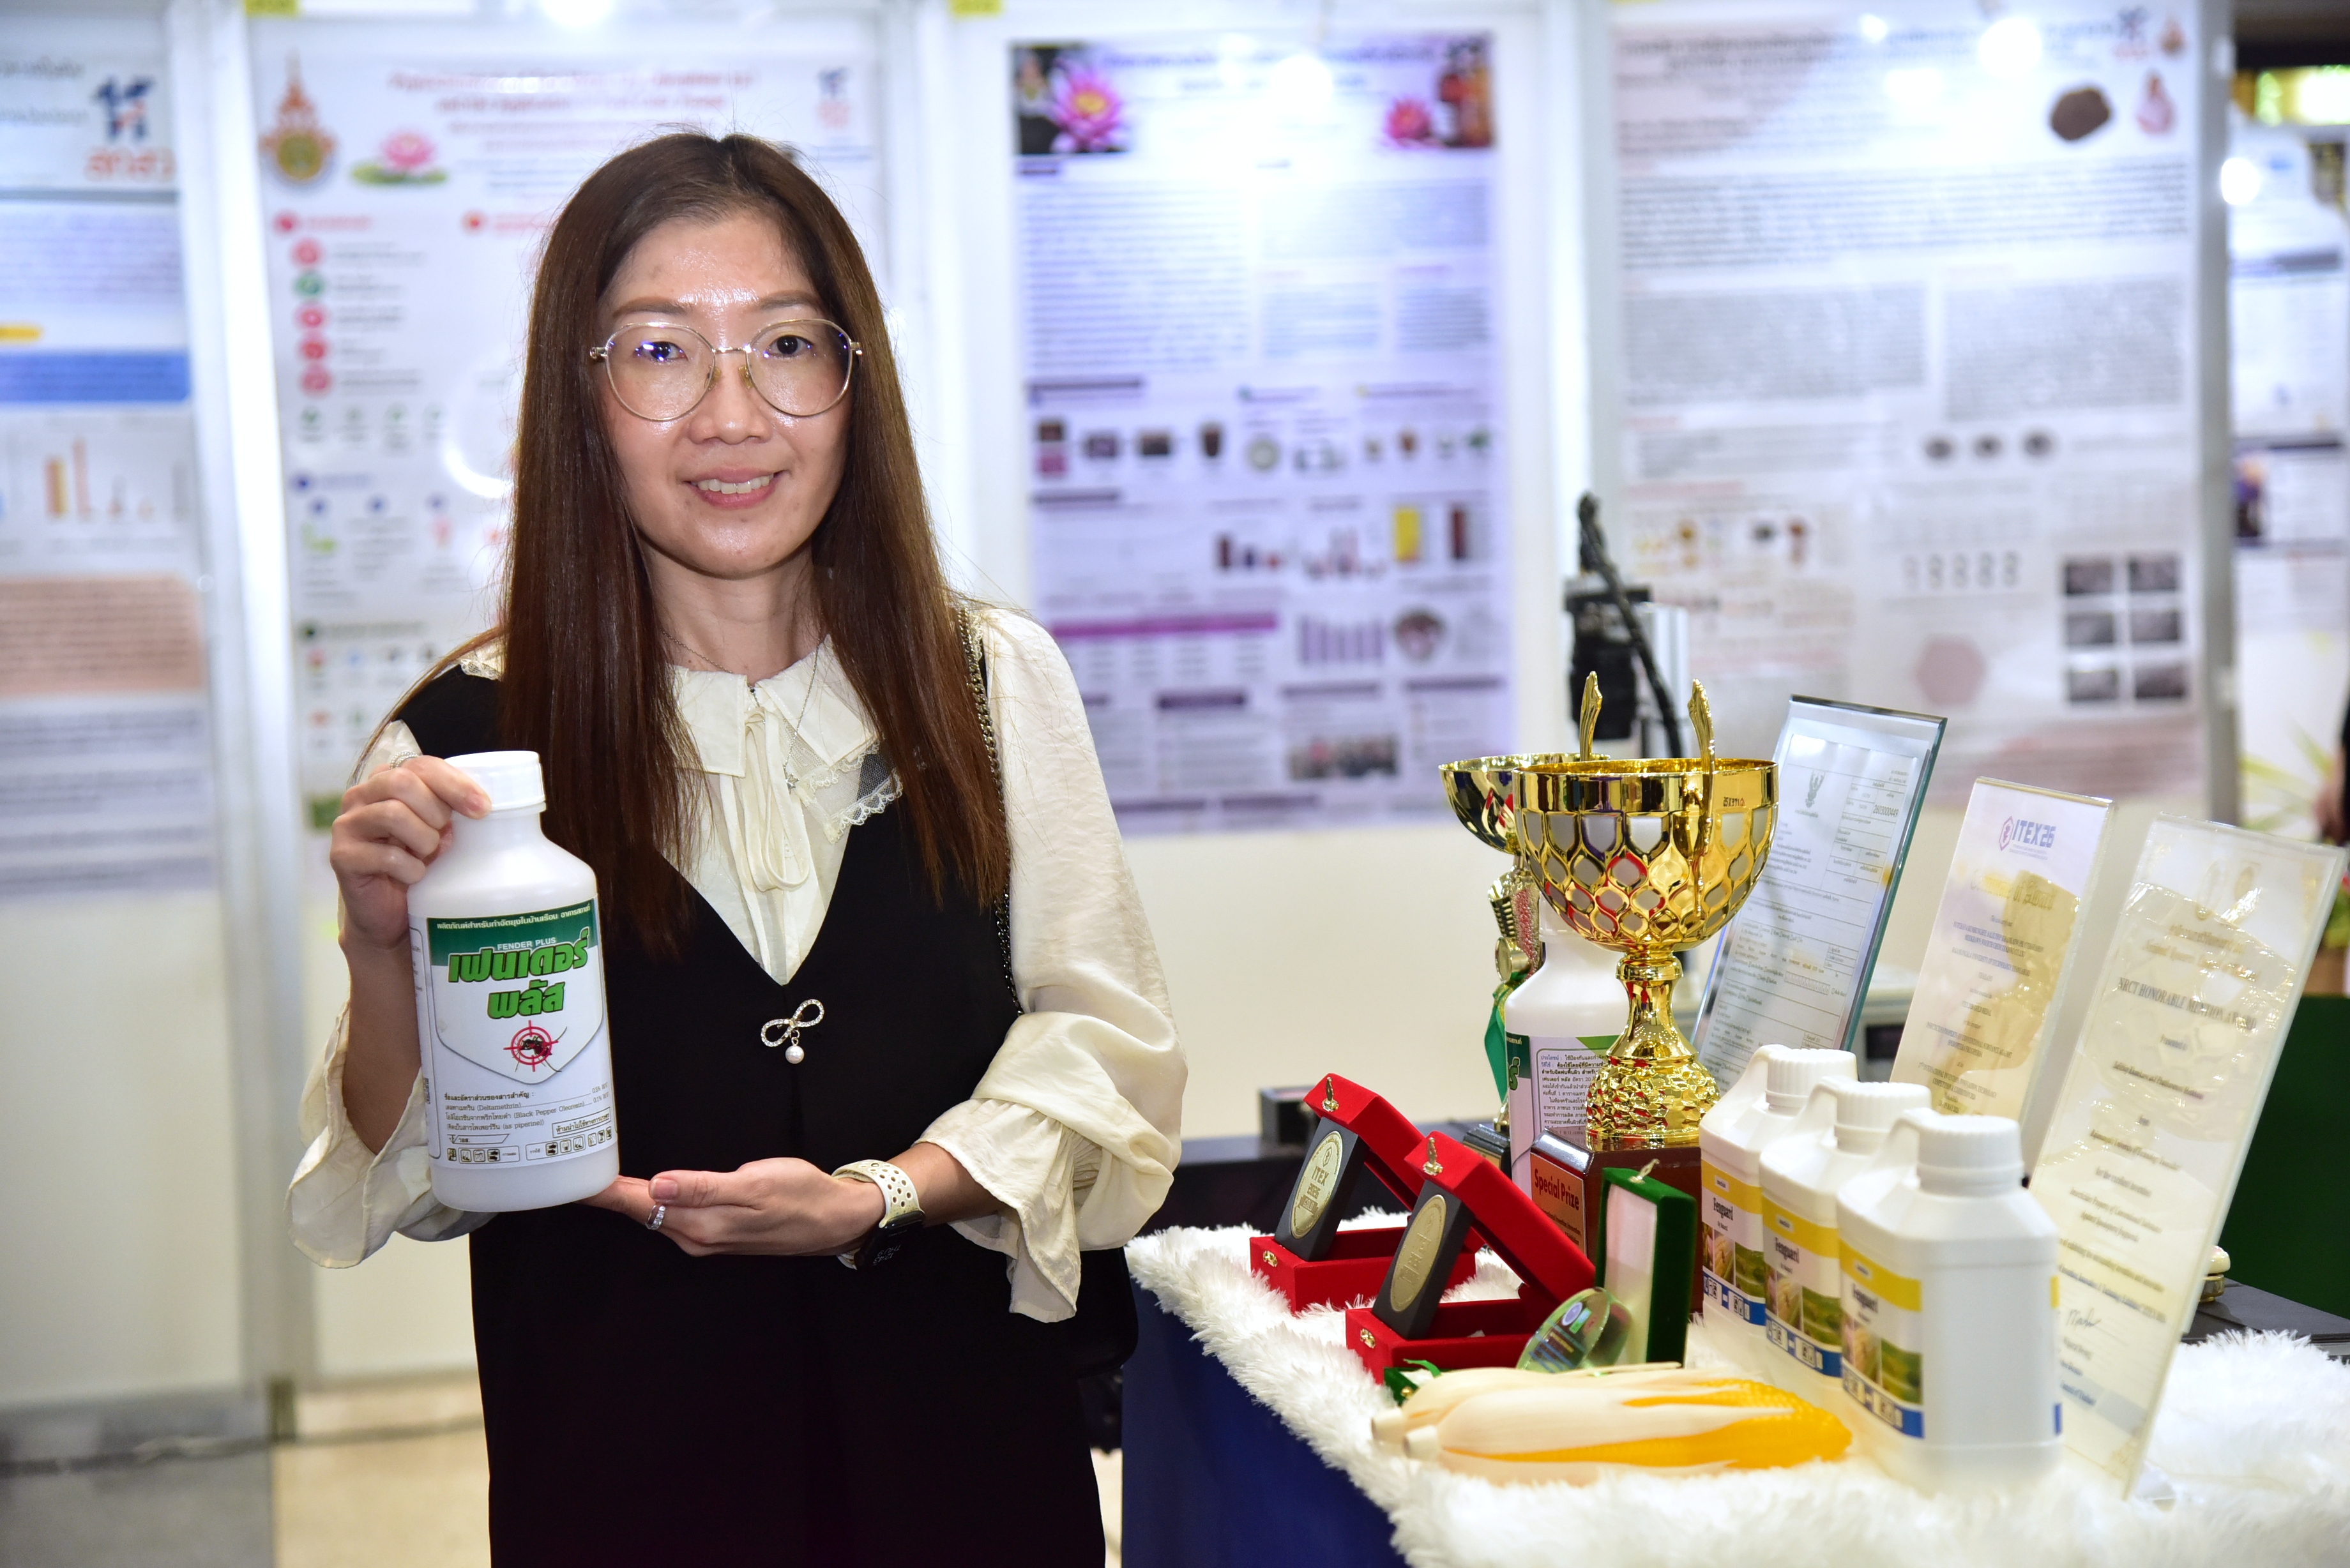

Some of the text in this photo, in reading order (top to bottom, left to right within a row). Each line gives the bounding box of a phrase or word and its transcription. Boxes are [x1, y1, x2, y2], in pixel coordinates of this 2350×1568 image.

[437, 914, 558, 930] ผลิตภัณฑ์สำหรับกำจัดยุงในบ้านเรือน
[497, 937, 556, 951] FENDER PLUS
[448, 926, 589, 983] เฟนเดอร์
[487, 979, 566, 1019] พลัส
[2118, 977, 2139, 994] NRCT
[2139, 983, 2187, 1009] HONORABLE
[535, 1108, 556, 1116] Pepper
[514, 1119, 544, 1129] piperine))
[1312, 1166, 1330, 1186] ITEX
[1535, 1168, 1580, 1211] Special Prize
